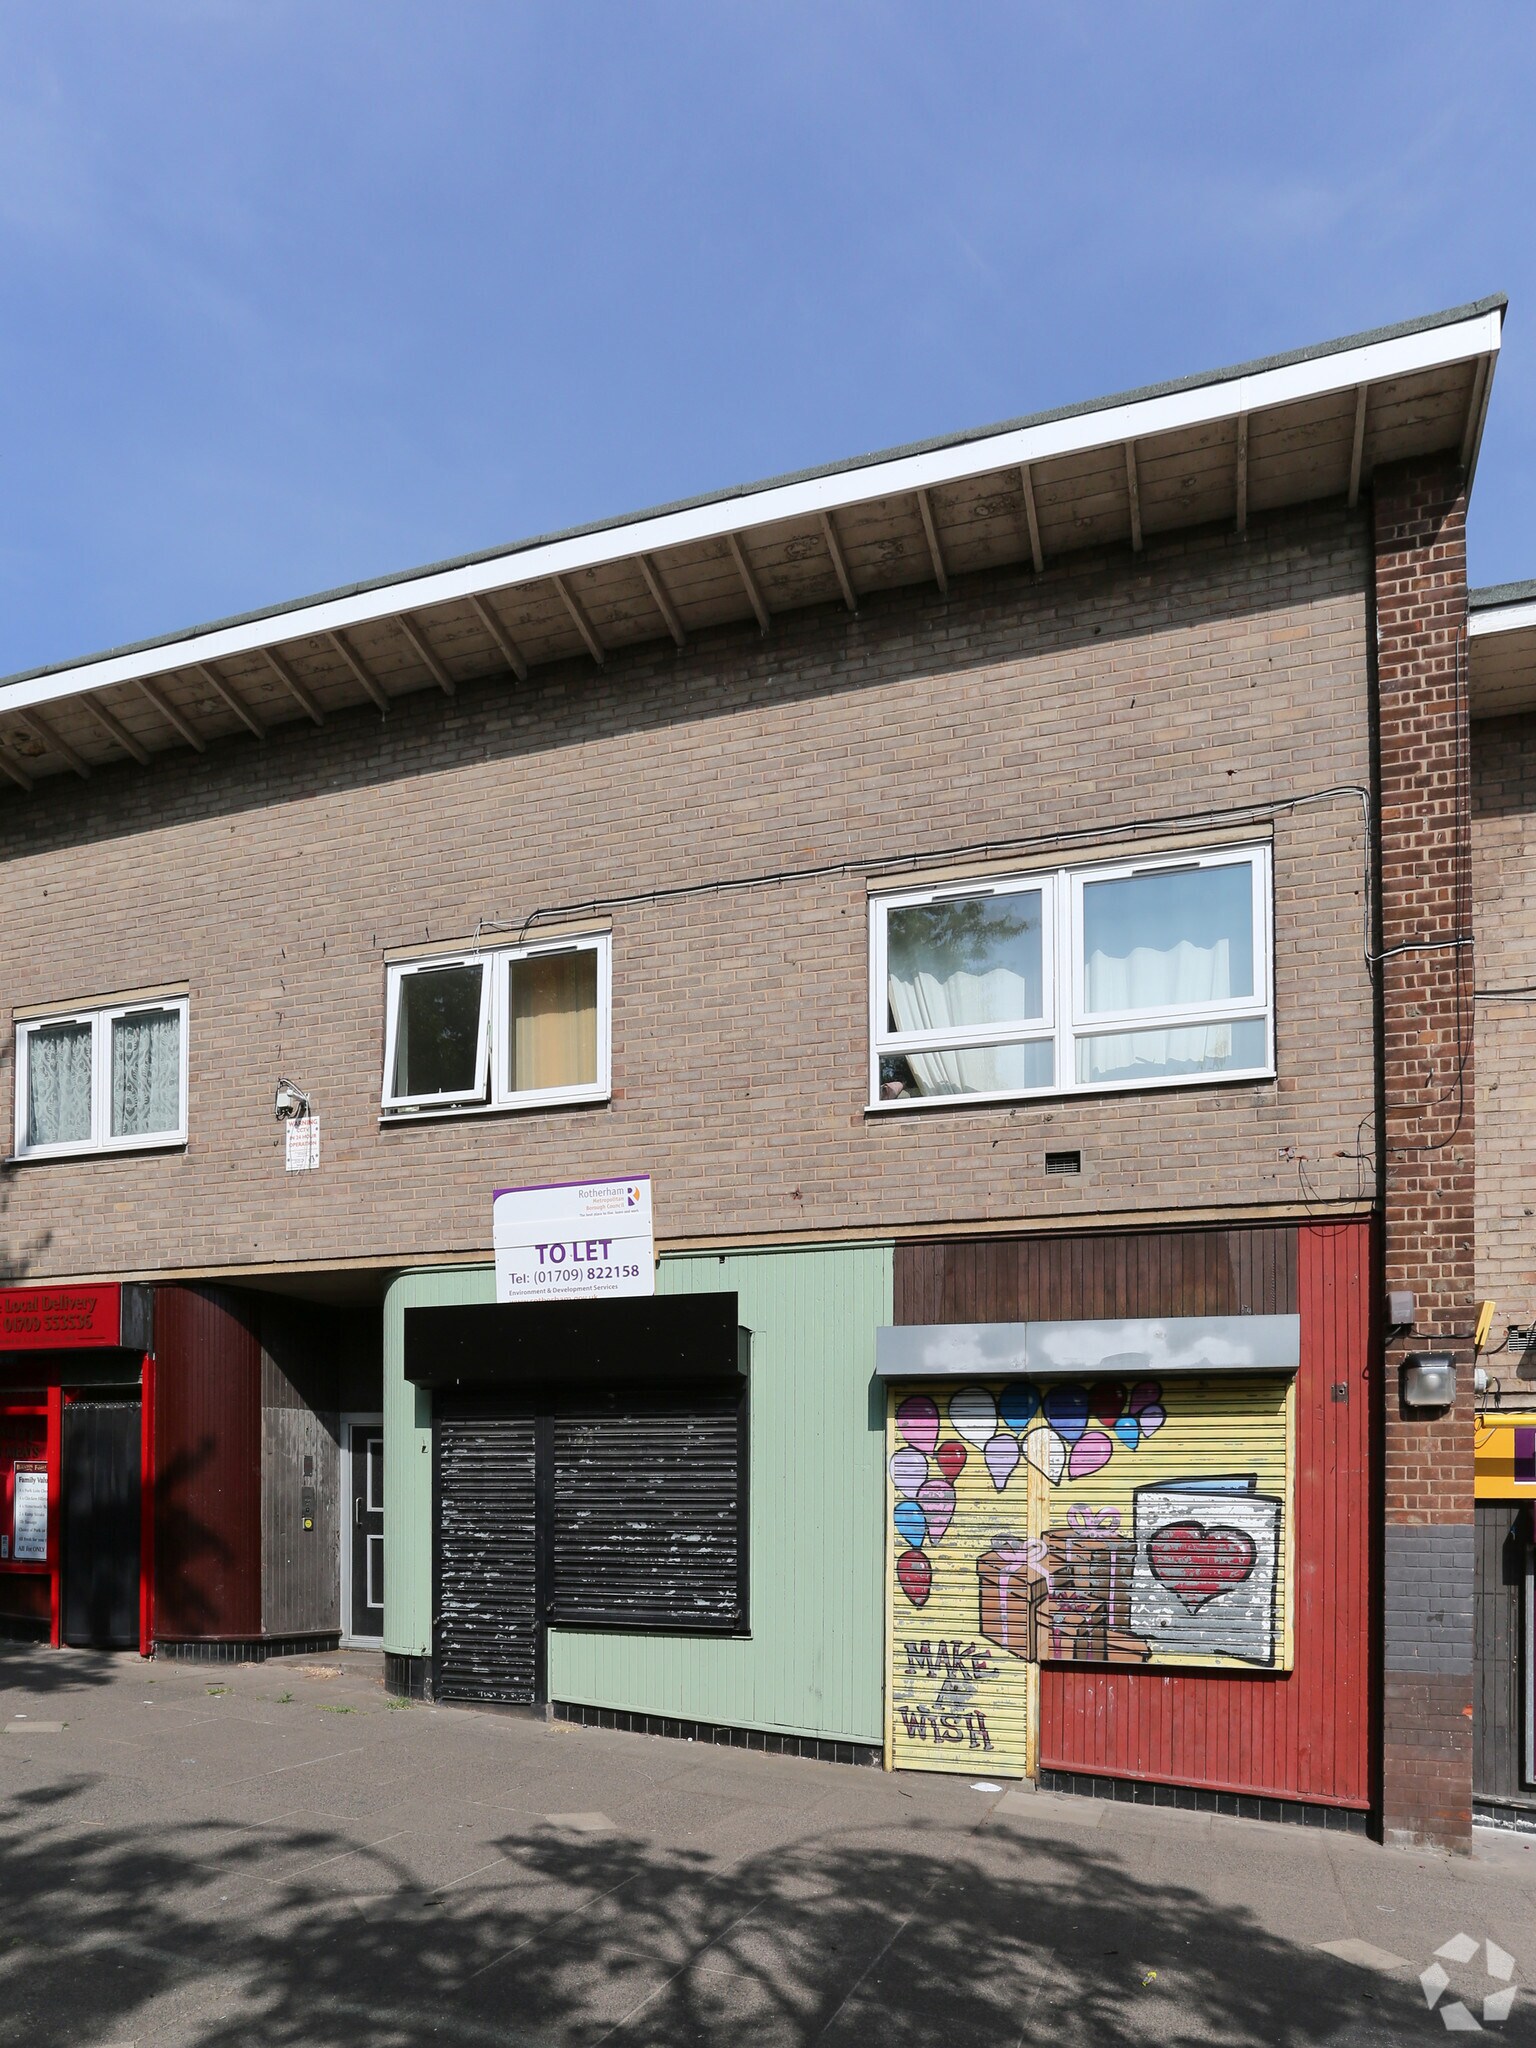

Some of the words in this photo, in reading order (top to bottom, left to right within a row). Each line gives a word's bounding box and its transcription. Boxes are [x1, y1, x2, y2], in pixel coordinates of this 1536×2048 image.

[578, 1187, 624, 1198] Rotherham
[535, 1243, 566, 1264] TO
[572, 1239, 612, 1262] LET
[509, 1272, 530, 1284] Tel:
[533, 1268, 583, 1285] (01709)
[587, 1264, 640, 1280] 822158
[509, 1287, 546, 1297] Environment
[547, 1286, 552, 1294] &
[553, 1284, 592, 1294] Development
[594, 1283, 618, 1291] Services
[5, 1296, 38, 1313] Local
[42, 1294, 98, 1314] Delivery
[4, 1316, 41, 1333] 01709
[43, 1313, 94, 1331] 553536
[18, 1475, 36, 1485] Family
[904, 1639, 1000, 1680] MAKE
[896, 1705, 994, 1751] WISH
